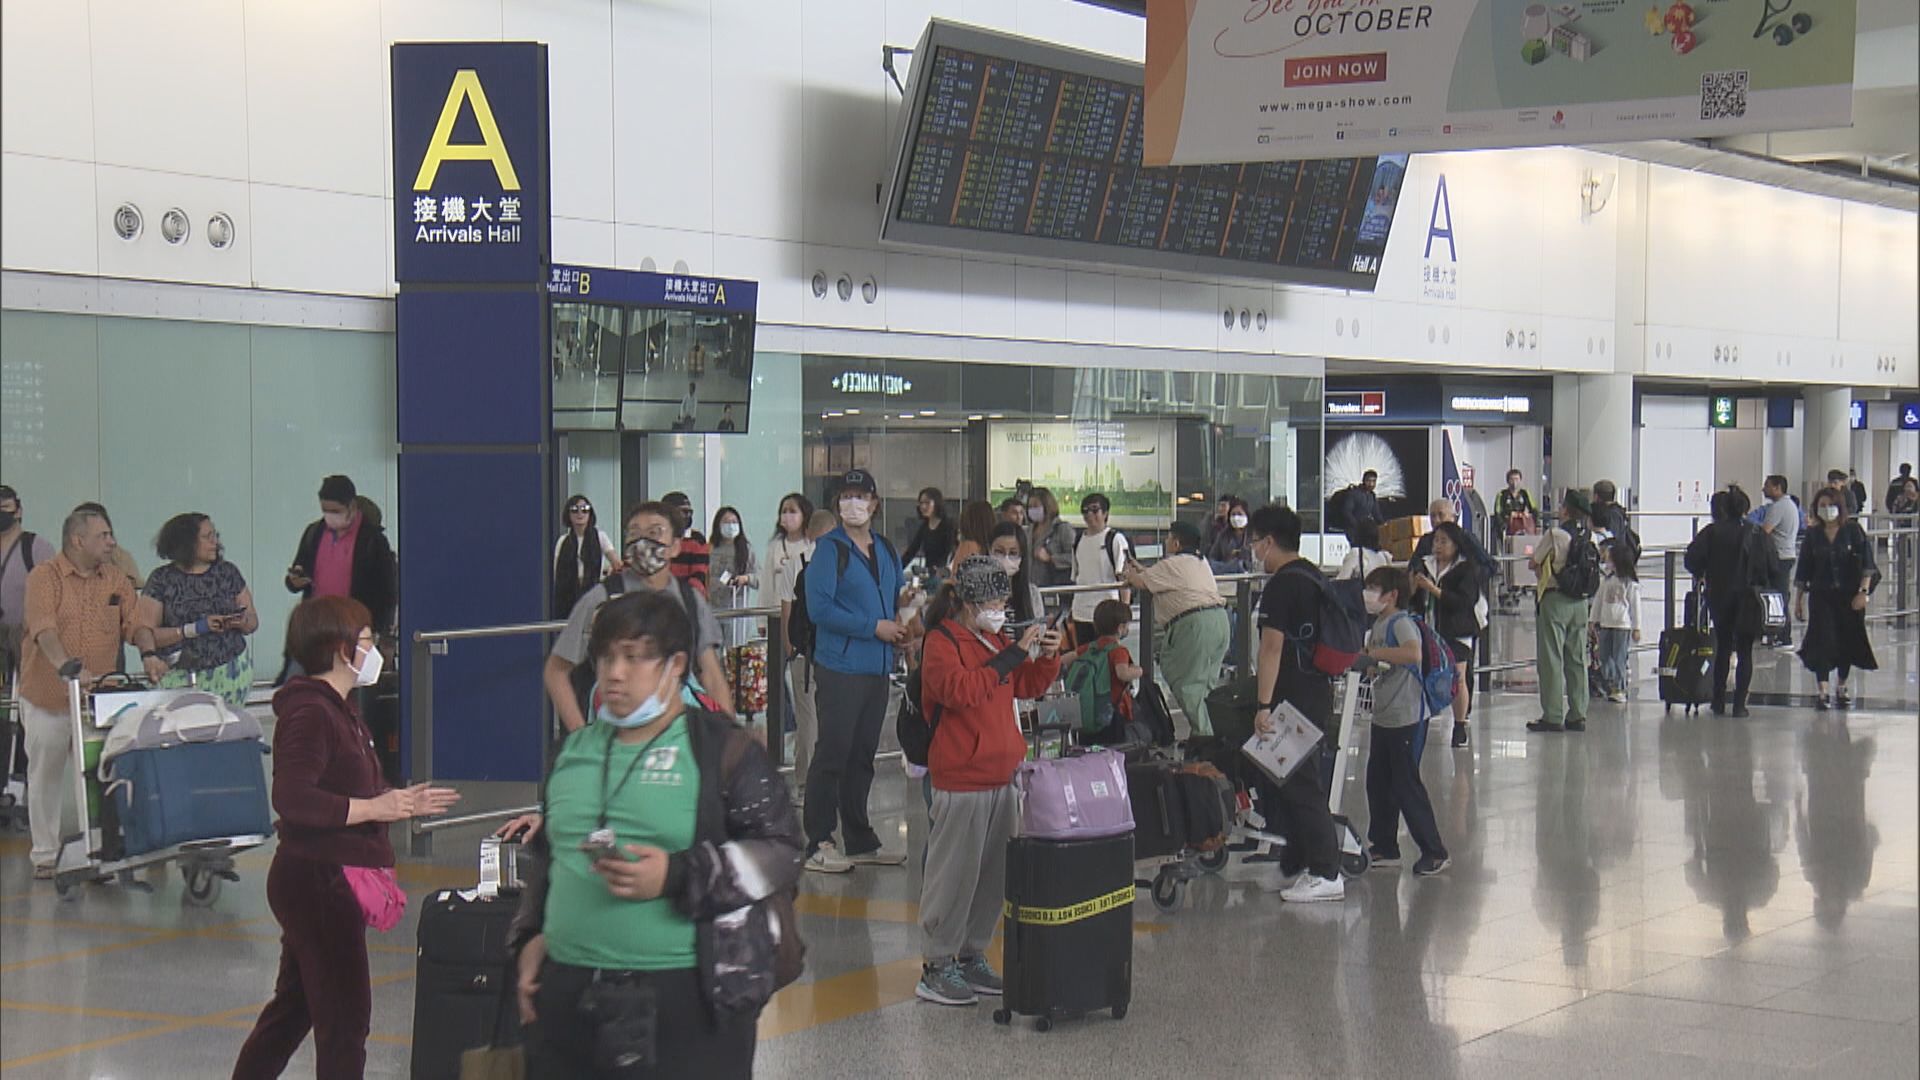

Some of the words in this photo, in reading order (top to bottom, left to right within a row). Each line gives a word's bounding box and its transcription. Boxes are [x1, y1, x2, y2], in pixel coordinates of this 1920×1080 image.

[1294, 6, 1432, 36] OCTOBER
[1292, 63, 1331, 80] JOIN
[1338, 61, 1378, 76] NOW
[1259, 95, 1412, 113] www.mega-show.com
[413, 69, 521, 191] A
[413, 196, 521, 222] 接機大堂
[1424, 173, 1457, 262] A
[415, 225, 482, 242] Arrivals
[488, 225, 520, 242] Hall
[1352, 255, 1370, 273] Hall
[1369, 257, 1377, 274] A
[579, 272, 590, 294] B
[714, 284, 726, 304] A
